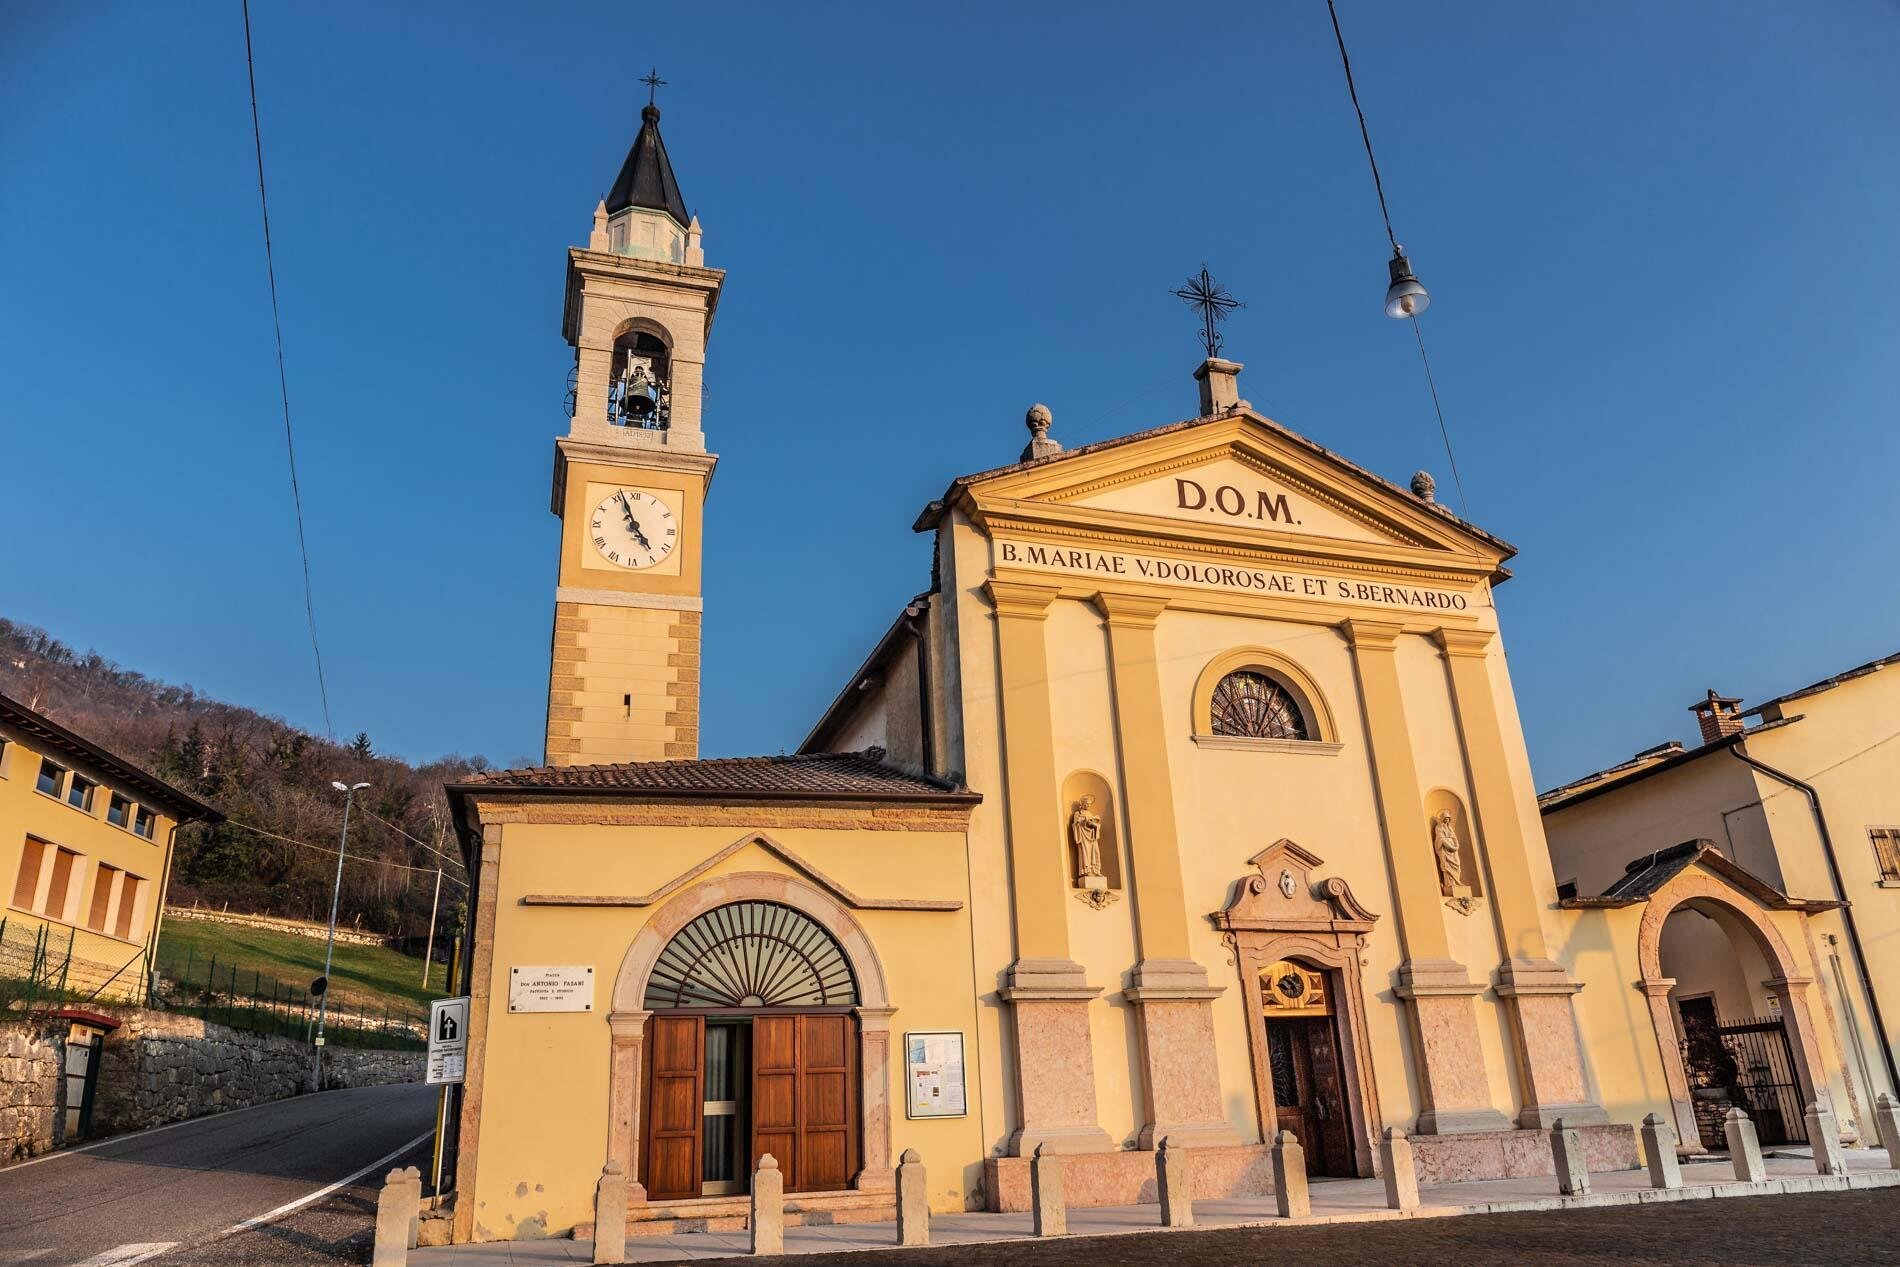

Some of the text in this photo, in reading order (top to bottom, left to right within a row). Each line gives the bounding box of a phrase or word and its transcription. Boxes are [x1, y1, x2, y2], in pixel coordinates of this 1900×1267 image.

[630, 492, 641, 501] XII
[1175, 478, 1302, 526] D.O.M.
[598, 505, 607, 513] X
[592, 520, 602, 528] IX
[666, 528, 675, 536] III
[661, 543, 671, 553] IV
[608, 551, 619, 562] VII
[649, 555, 656, 564] V
[628, 557, 637, 566] VI
[1302, 578, 1328, 596] ET
